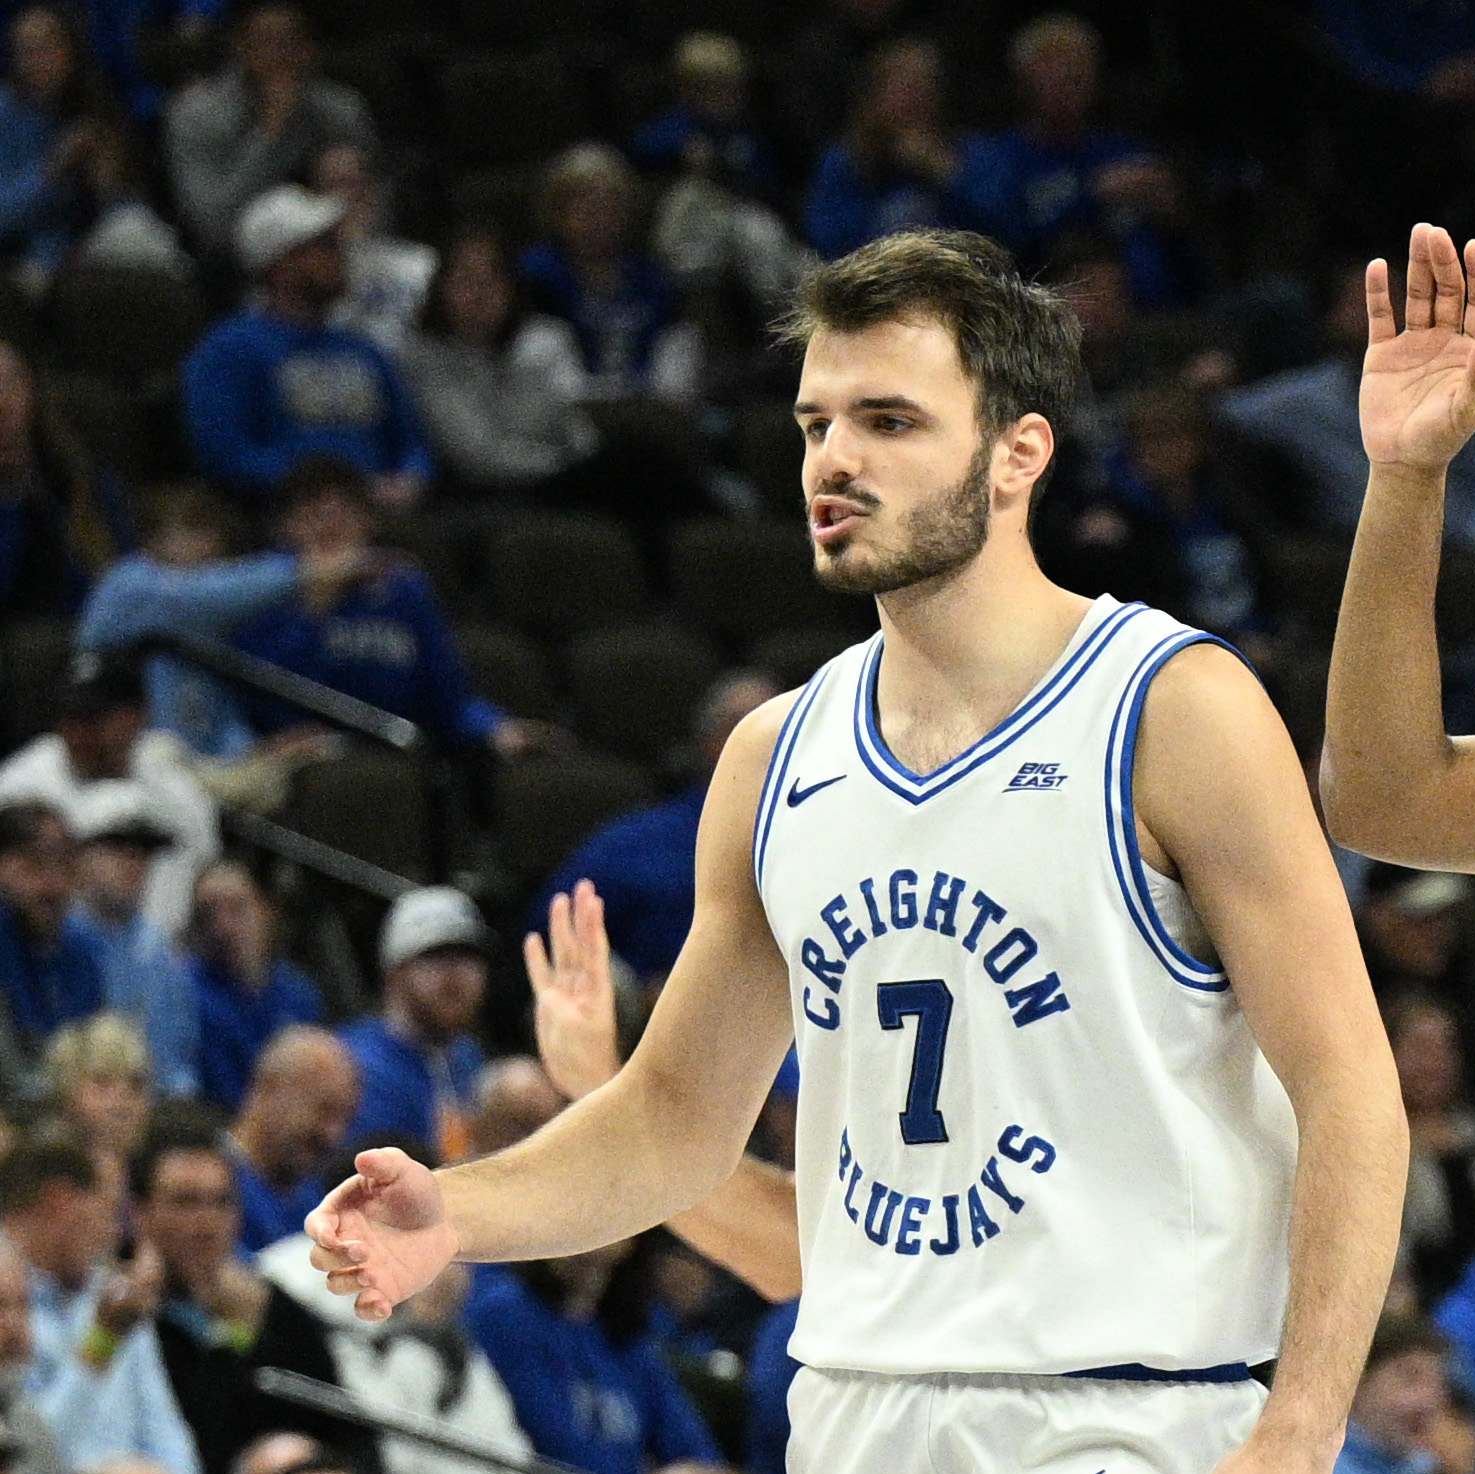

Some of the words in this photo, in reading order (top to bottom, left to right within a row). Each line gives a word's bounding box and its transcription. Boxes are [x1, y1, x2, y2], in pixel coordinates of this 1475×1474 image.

[1008, 775, 1068, 787] EAST
[1017, 762, 1061, 775] BIG
[801, 869, 1070, 1030] CREIGHTON
[876, 979, 954, 1146] 7
